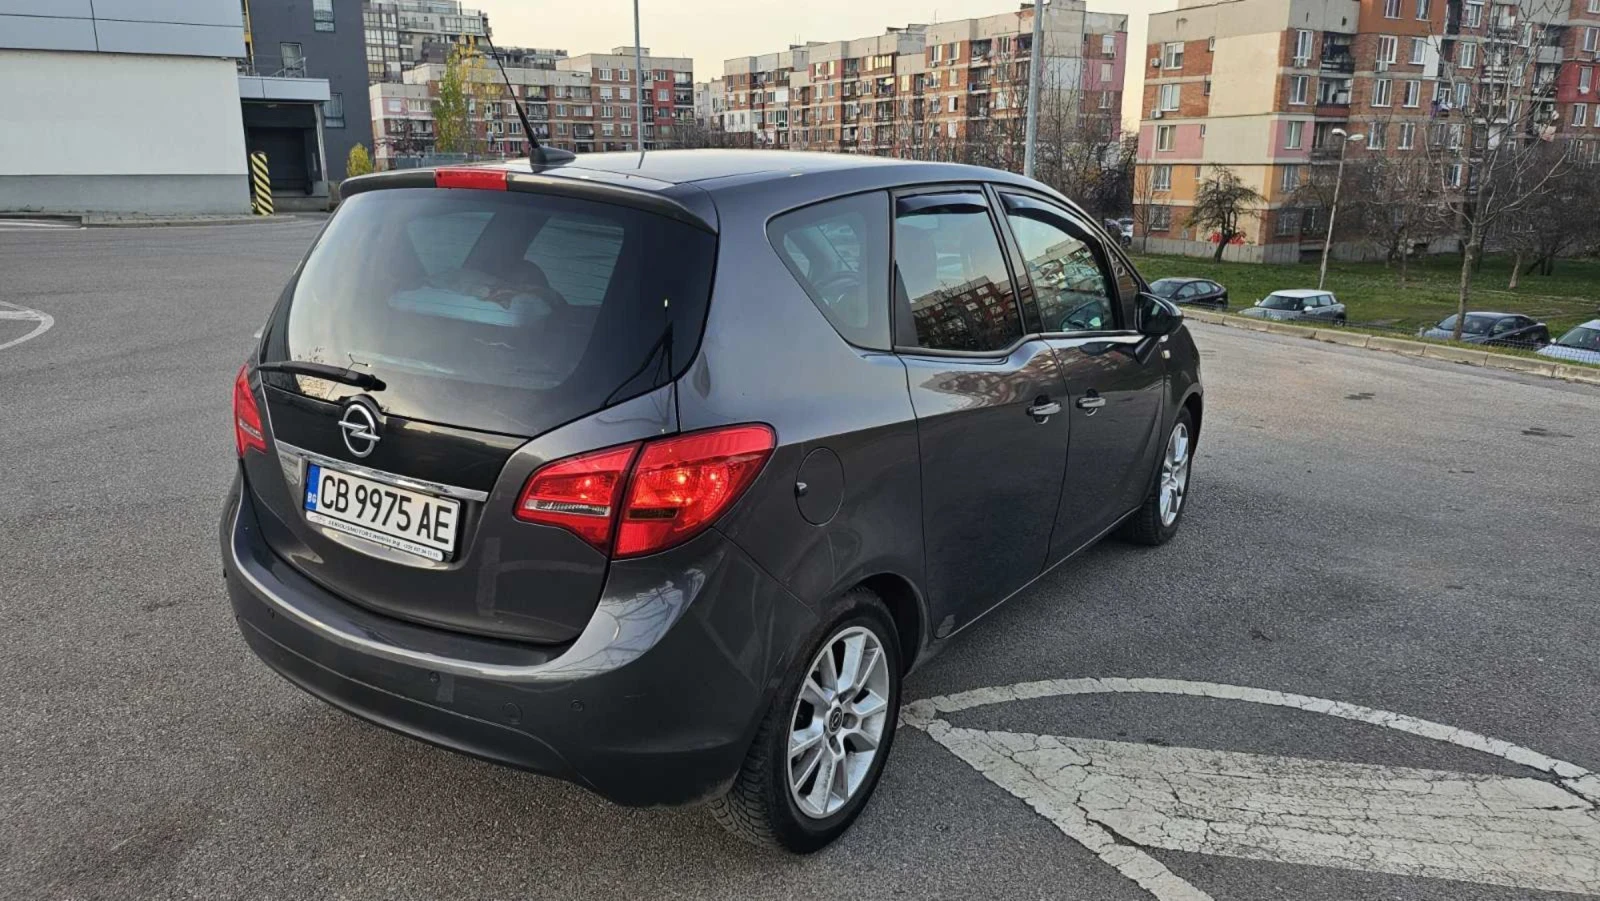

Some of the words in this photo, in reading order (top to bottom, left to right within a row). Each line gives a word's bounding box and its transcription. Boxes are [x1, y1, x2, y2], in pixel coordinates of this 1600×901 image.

[307, 492, 317, 504] BG
[321, 475, 349, 513] CB
[355, 484, 412, 532] 9975
[417, 502, 452, 544] AE
